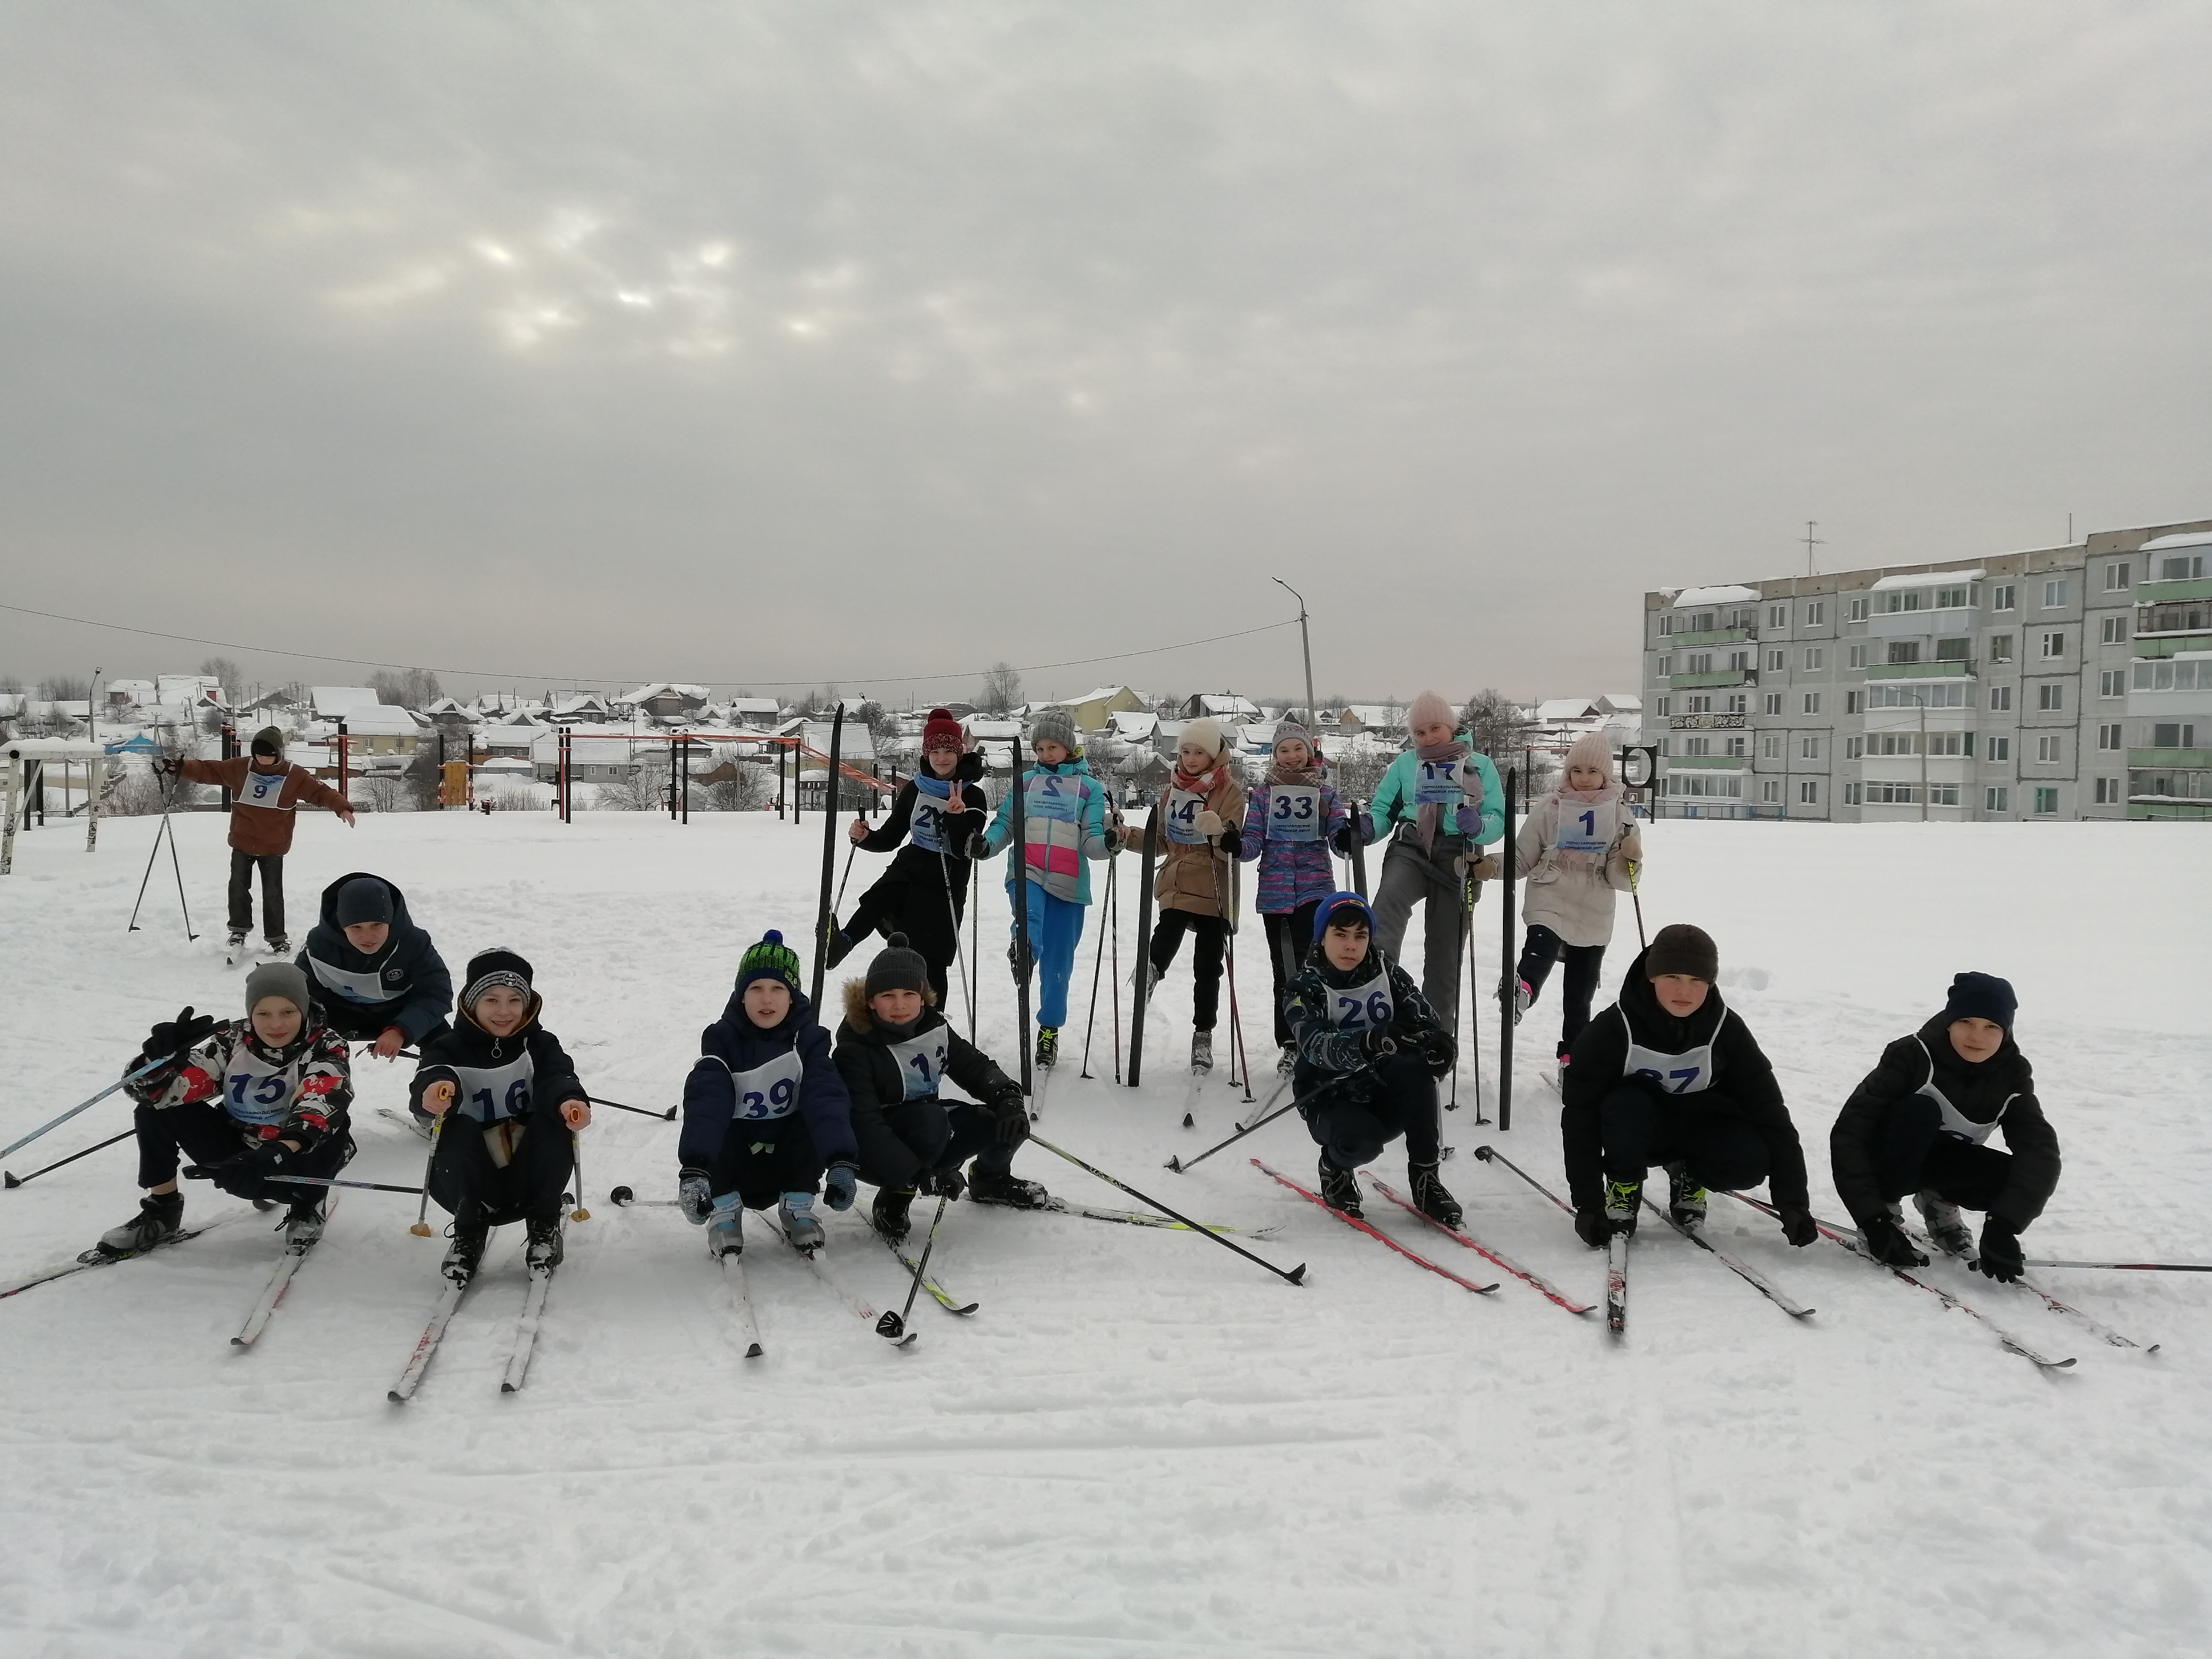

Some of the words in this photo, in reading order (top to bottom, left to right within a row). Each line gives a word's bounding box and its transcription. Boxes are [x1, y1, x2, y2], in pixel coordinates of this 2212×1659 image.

[1422, 761, 1456, 780] 17
[1274, 795, 1313, 819] 33
[1579, 810, 1594, 836] 1
[1338, 991, 1391, 1030] 26
[229, 1073, 287, 1104] 15
[472, 1079, 530, 1122] 16
[743, 1078, 795, 1118] 39
